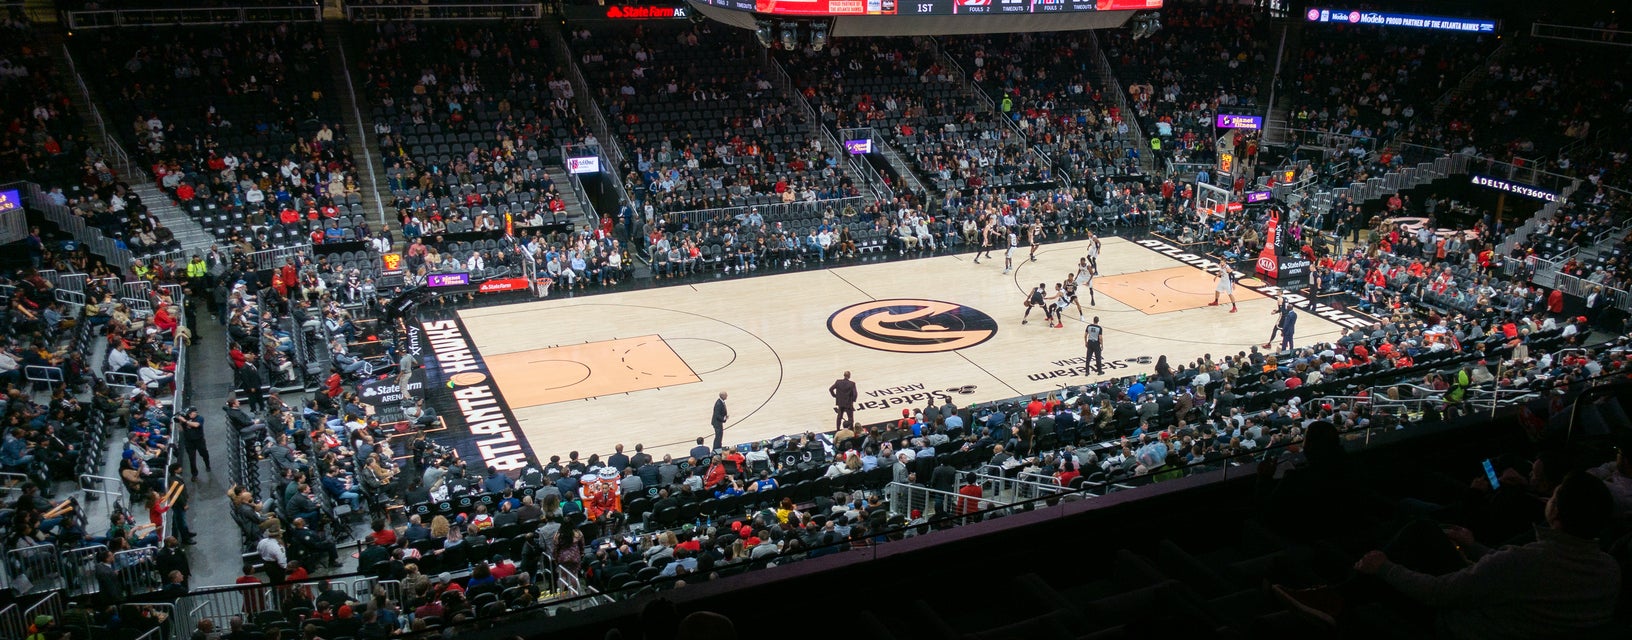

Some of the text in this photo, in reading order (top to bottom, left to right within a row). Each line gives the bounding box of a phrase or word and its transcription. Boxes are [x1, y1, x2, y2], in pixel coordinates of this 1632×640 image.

[917, 4, 933, 12] 1ST
[1361, 13, 1385, 24] Modelo
[1386, 17, 1402, 26] PROUD
[1402, 18, 1423, 27] PARTNER
[1431, 20, 1441, 28] THE
[1441, 21, 1461, 30] ATLANTA
[1461, 22, 1479, 31] HAWKS
[1481, 178, 1510, 191] DELTA
[1274, 224, 1282, 247] xfinity
[1260, 259, 1273, 270] KIA
[409, 326, 421, 355] xfinity
[422, 319, 480, 374] HAWKS
[381, 393, 404, 402] AREN
[865, 382, 926, 397] ARENA
[453, 385, 528, 471] ATLANTA
